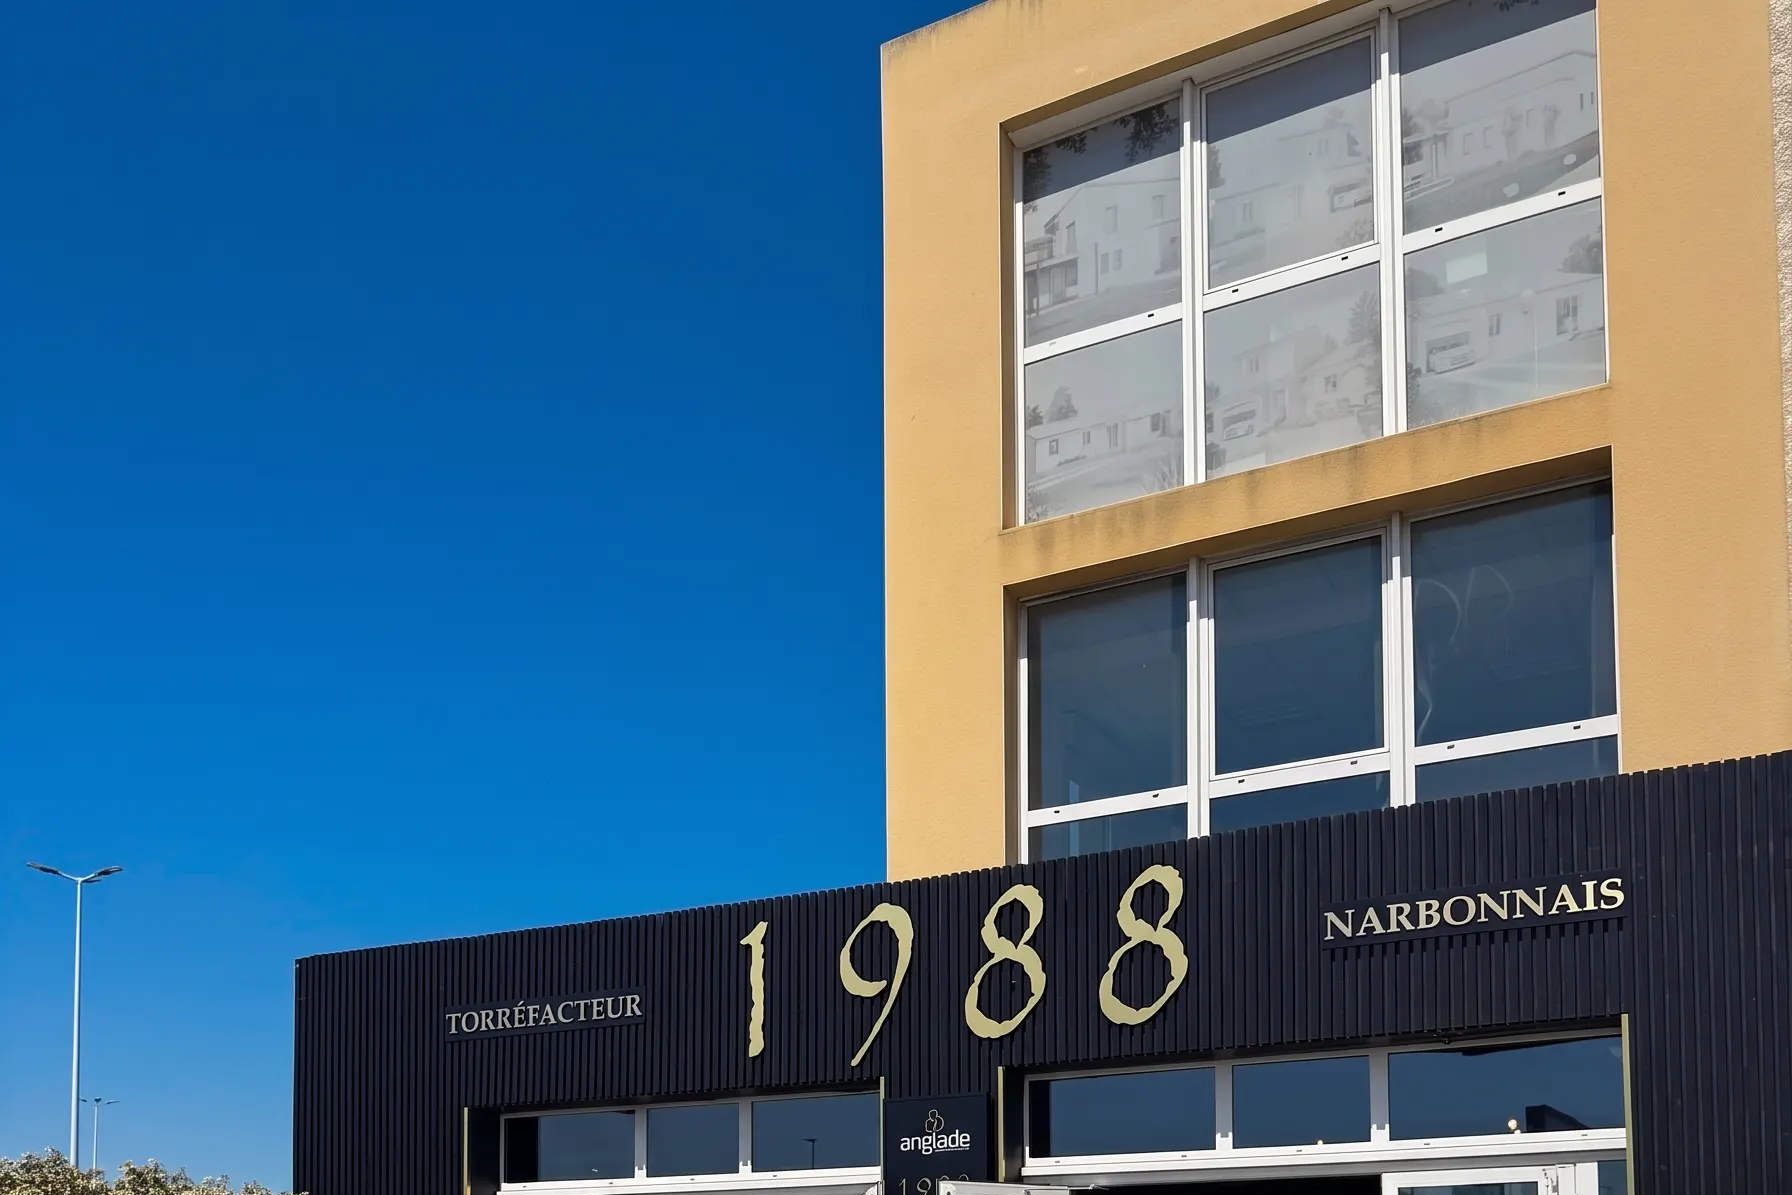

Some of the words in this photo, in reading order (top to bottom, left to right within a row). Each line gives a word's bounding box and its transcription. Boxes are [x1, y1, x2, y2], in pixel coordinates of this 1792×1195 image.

[1323, 877, 1626, 941] NARBONNAIS
[740, 863, 1189, 1067] 1988
[445, 993, 643, 1036] TORRÉFACTEUR
[900, 1129, 971, 1155] anglade
